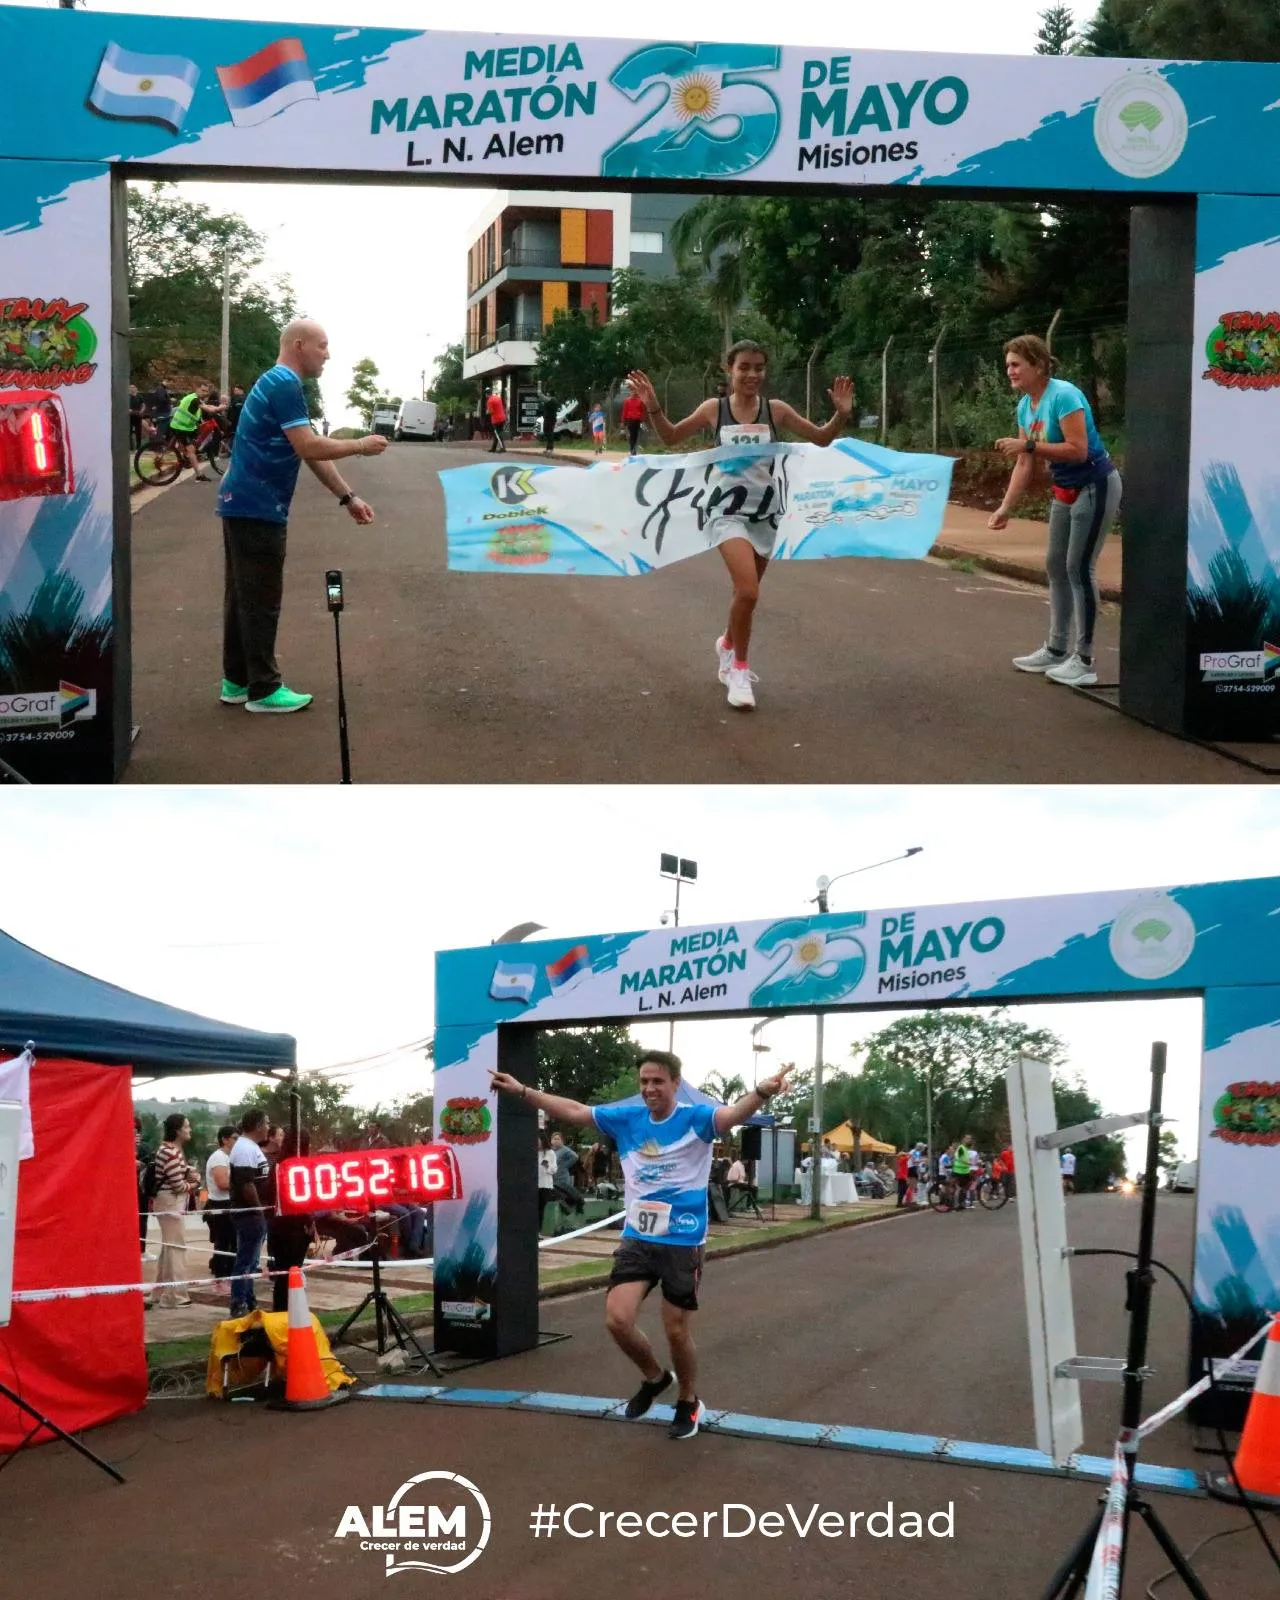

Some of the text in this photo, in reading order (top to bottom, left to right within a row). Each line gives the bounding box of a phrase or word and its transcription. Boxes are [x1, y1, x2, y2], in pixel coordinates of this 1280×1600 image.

[463, 42, 584, 80] MEDIA
[803, 56, 851, 89] DE
[370, 75, 597, 134] MARATÓN
[601, 42, 780, 178] 25
[798, 76, 969, 140] MAYO
[406, 131, 564, 166] L. N. Alem
[798, 141, 918, 171] Misiones
[1203, 654, 1261, 669] ProGraf
[670, 925, 739, 957] MEDIA
[881, 911, 916, 938] DE
[750, 910, 867, 1008] 25
[878, 916, 1005, 973] MAYO
[620, 948, 747, 995] MARATÓN
[878, 966, 966, 994] Misiones
[638, 983, 728, 1011] L. N. Alem
[288, 1153, 445, 1203] 00:52:16
[638, 1210, 659, 1233] 97
